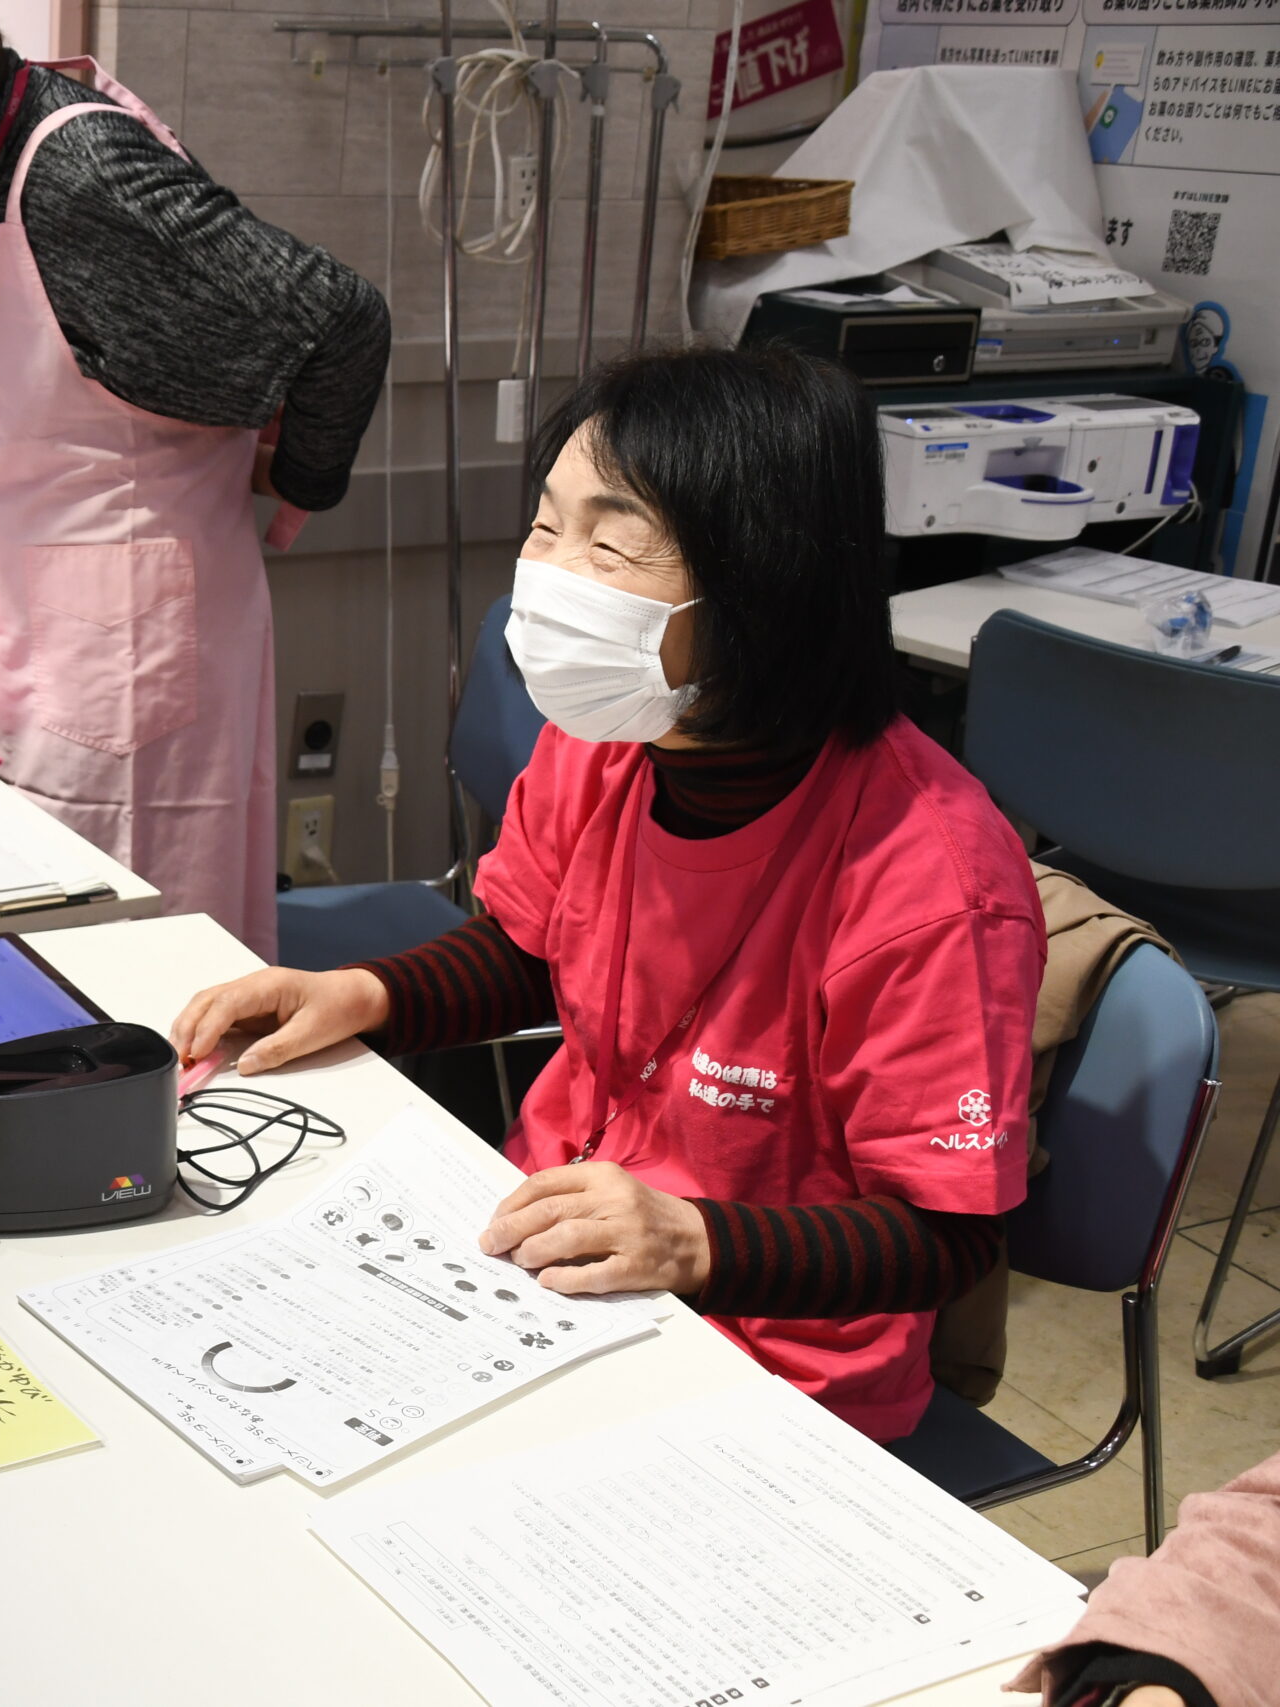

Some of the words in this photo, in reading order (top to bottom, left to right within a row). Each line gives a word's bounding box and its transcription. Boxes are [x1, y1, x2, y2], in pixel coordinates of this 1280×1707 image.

[688, 1078, 775, 1113] 私達の手で
[102, 1185, 151, 1202] VIEW
[352, 1423, 384, 1441] 判定
